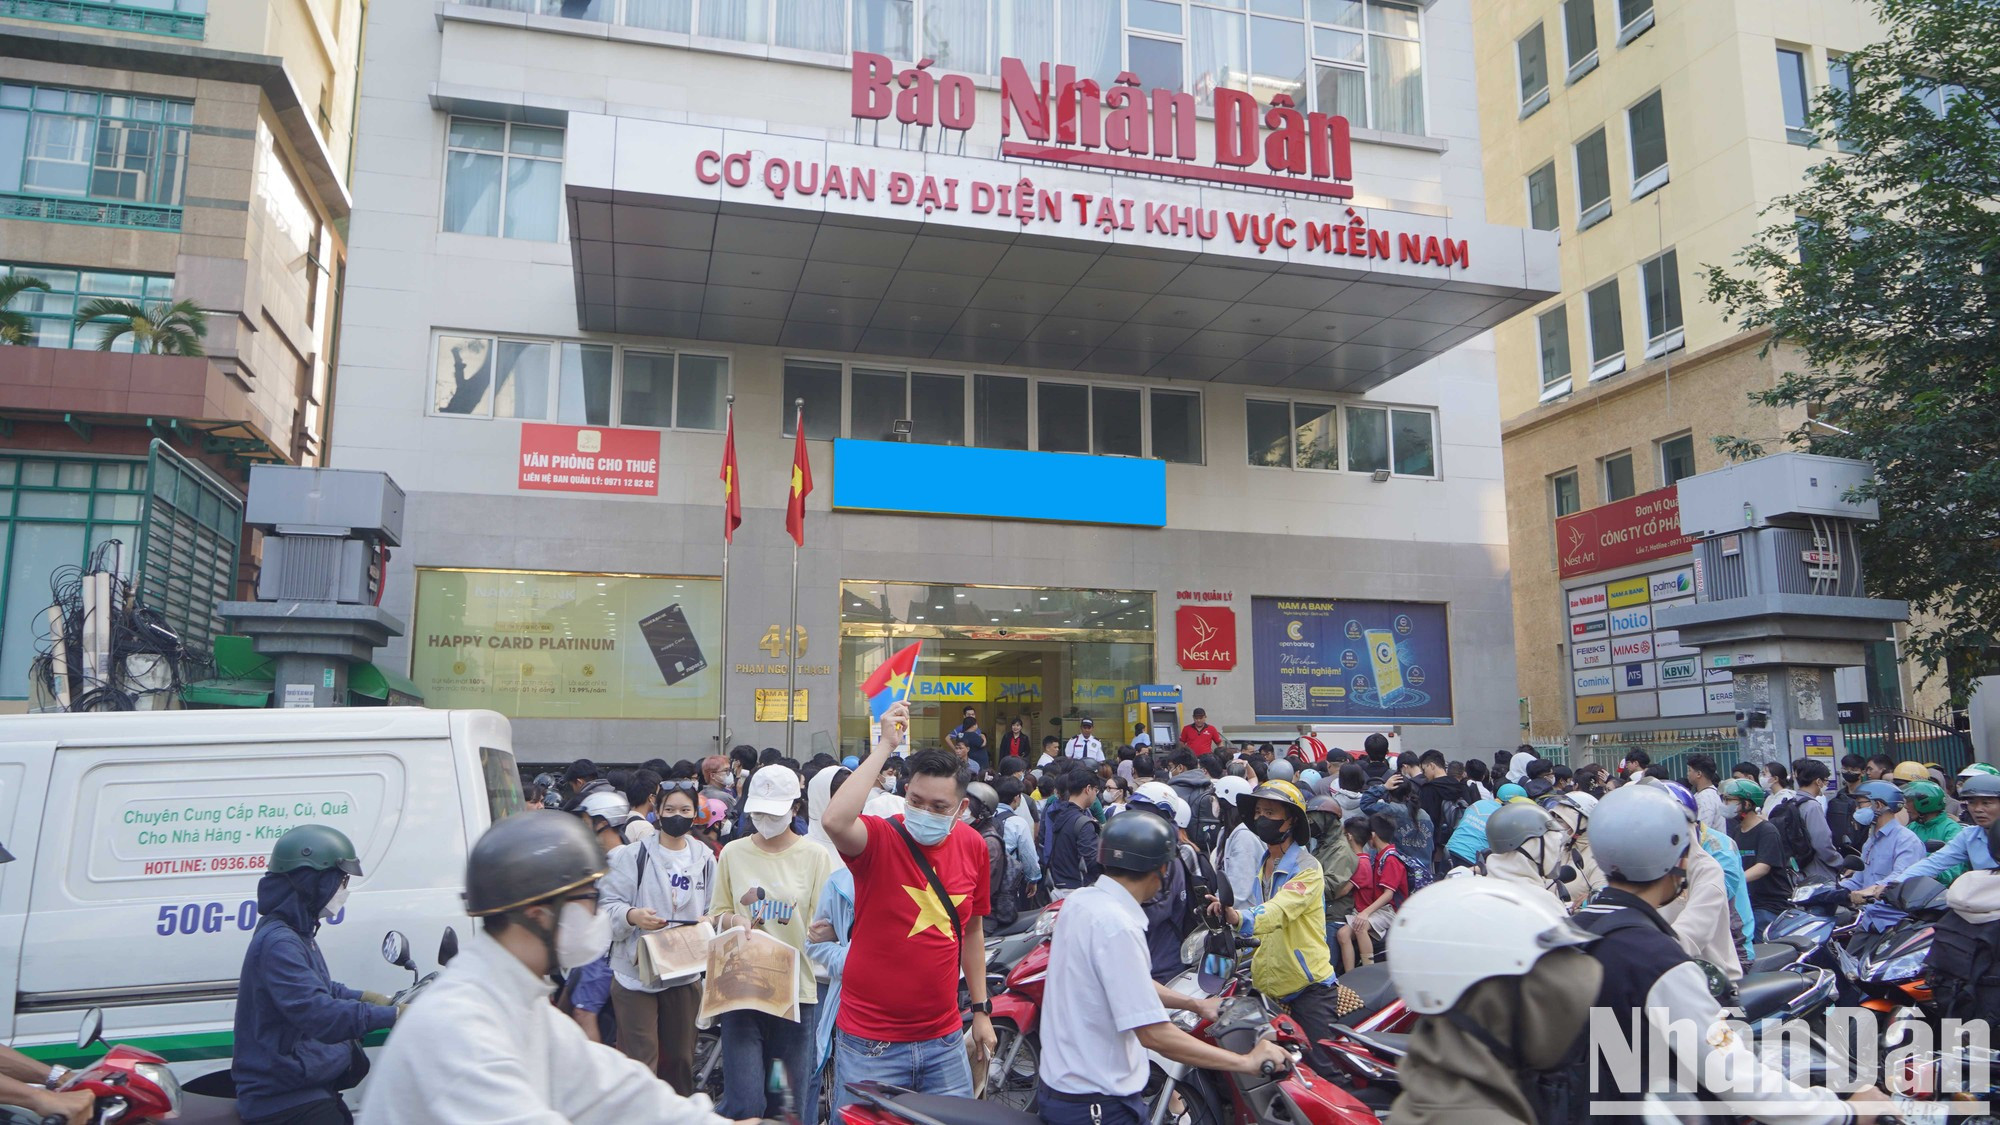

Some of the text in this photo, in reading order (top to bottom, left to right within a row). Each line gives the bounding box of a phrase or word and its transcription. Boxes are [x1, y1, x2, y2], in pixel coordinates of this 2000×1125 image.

[852, 50, 1353, 181] Báo Nhân Dân
[695, 150, 1469, 269] CƠ QUAN ĐẠI DIỆN TẠI KHU VỰC MIỀN NAM
[523, 452, 657, 473] VĂN PHÒNG CHO THUÊ
[523, 472, 541, 482] LIÊN
[541, 473, 552, 484] HỆ
[553, 474, 569, 484] BAN
[570, 473, 591, 485] QUẢN
[604, 477, 622, 487] 0971
[624, 478, 633, 487] 12
[634, 478, 644, 488] 82
[645, 479, 654, 488] 82
[1635, 505, 1653, 518] Đơn
[1653, 501, 1662, 515] Vị
[1600, 527, 1628, 547] CÔNG
[1629, 525, 1641, 540] TY
[1643, 516, 1657, 536] CỔ
[1564, 552, 1595, 568] Nest Art
[1629, 587, 1645, 596] BANK
[1653, 581, 1676, 593] palma
[1176, 590, 1233, 602] ĐƠN VỊ QUẢN LÝ
[429, 635, 615, 651] HAPPY CARD PLATINUM
[759, 624, 809, 659] 40
[1183, 648, 1230, 661] Nest Art
[1613, 643, 1640, 656] MIMS
[735, 664, 830, 676] PHẠM NGỌ THẠCH
[1281, 666, 1342, 677] mọi trải nghiệm!
[1628, 670, 1641, 680] ATS
[1664, 665, 1690, 677] KBVN
[1212, 677, 1218, 685] 7
[1577, 675, 1610, 688] Cominix
[920, 681, 974, 696] BANK
[1126, 688, 1139, 702] ATM
[124, 800, 349, 826] Chuyên Cung Cấp Rau, Củ, Quả
[138, 831, 167, 845] Cho
[144, 859, 206, 875] HOTLINE:
